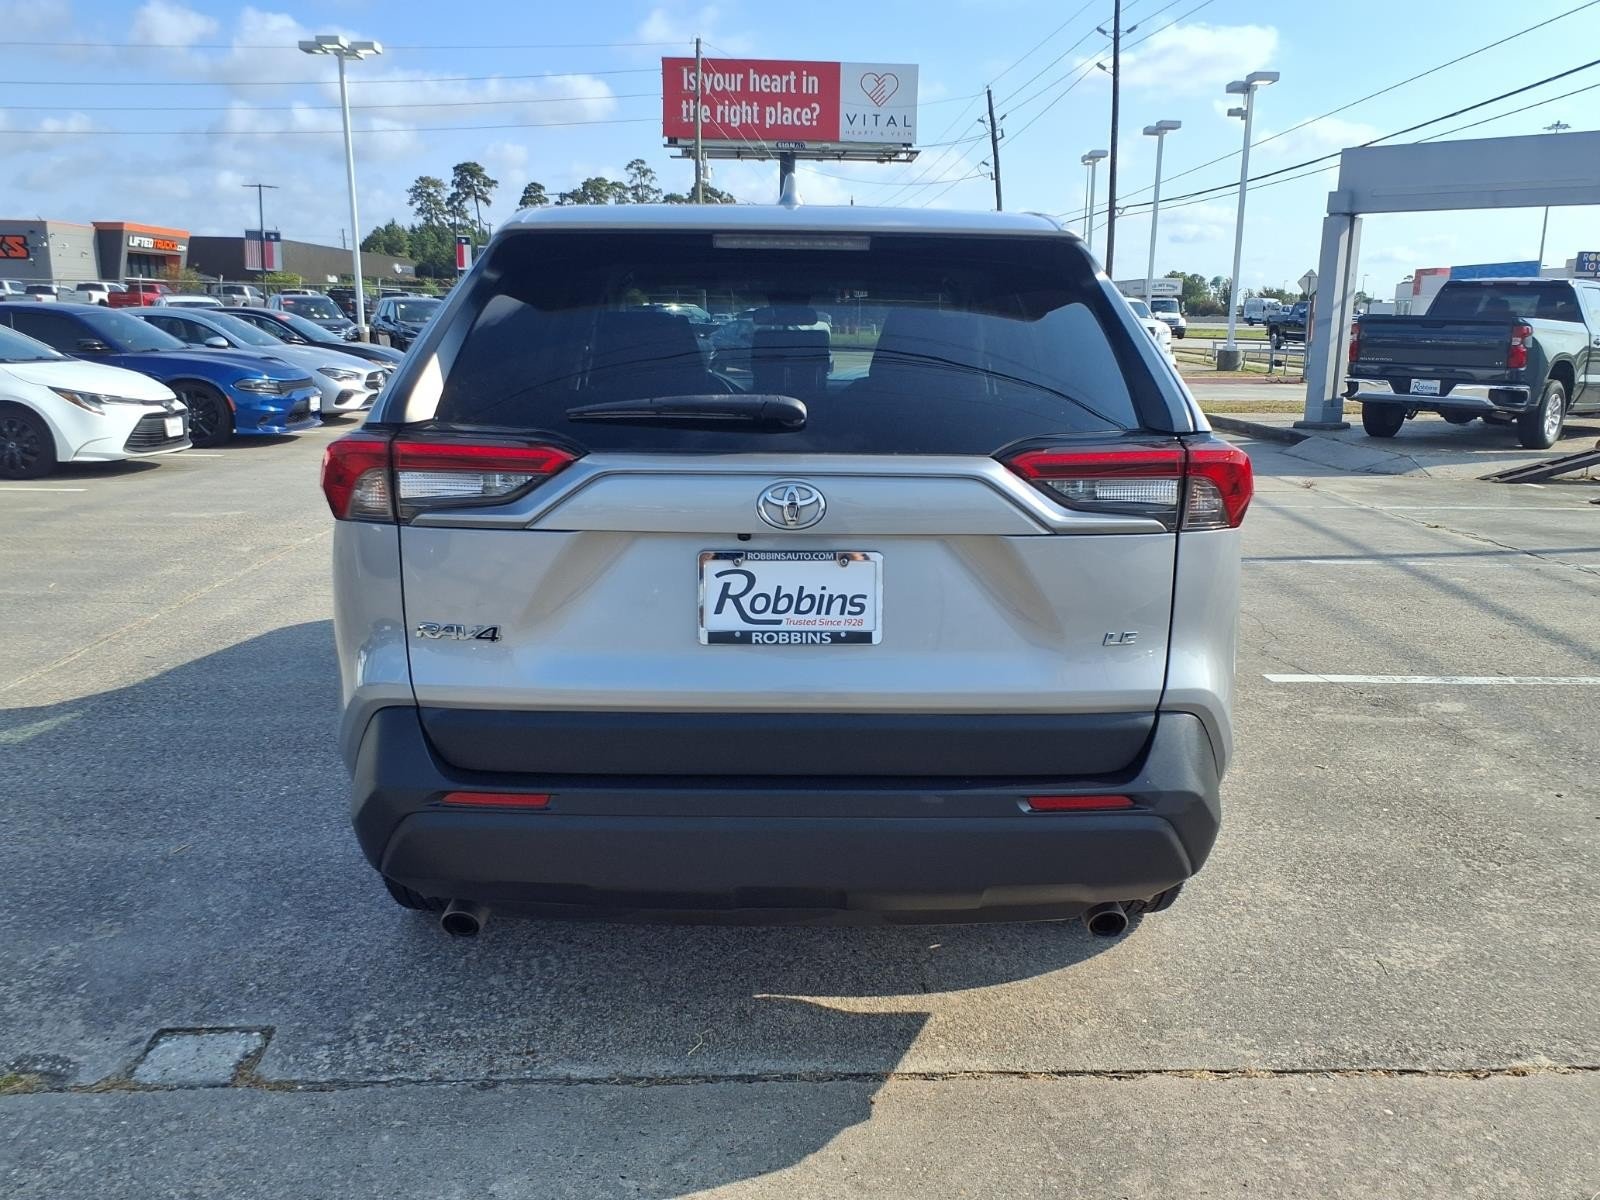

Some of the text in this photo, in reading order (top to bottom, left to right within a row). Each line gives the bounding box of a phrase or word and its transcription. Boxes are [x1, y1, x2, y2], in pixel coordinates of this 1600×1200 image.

[683, 67, 818, 95] Is your heart in
[716, 100, 759, 127] right
[765, 101, 820, 128] place?
[845, 113, 912, 127] VITAL
[747, 552, 834, 561] ROBBINSAUTO.COM
[713, 569, 868, 626] Robbins
[785, 617, 864, 627] Trusted Since 1928
[416, 622, 501, 641] RAV4
[751, 631, 832, 645] ROBBINS
[1102, 631, 1138, 646] LE
